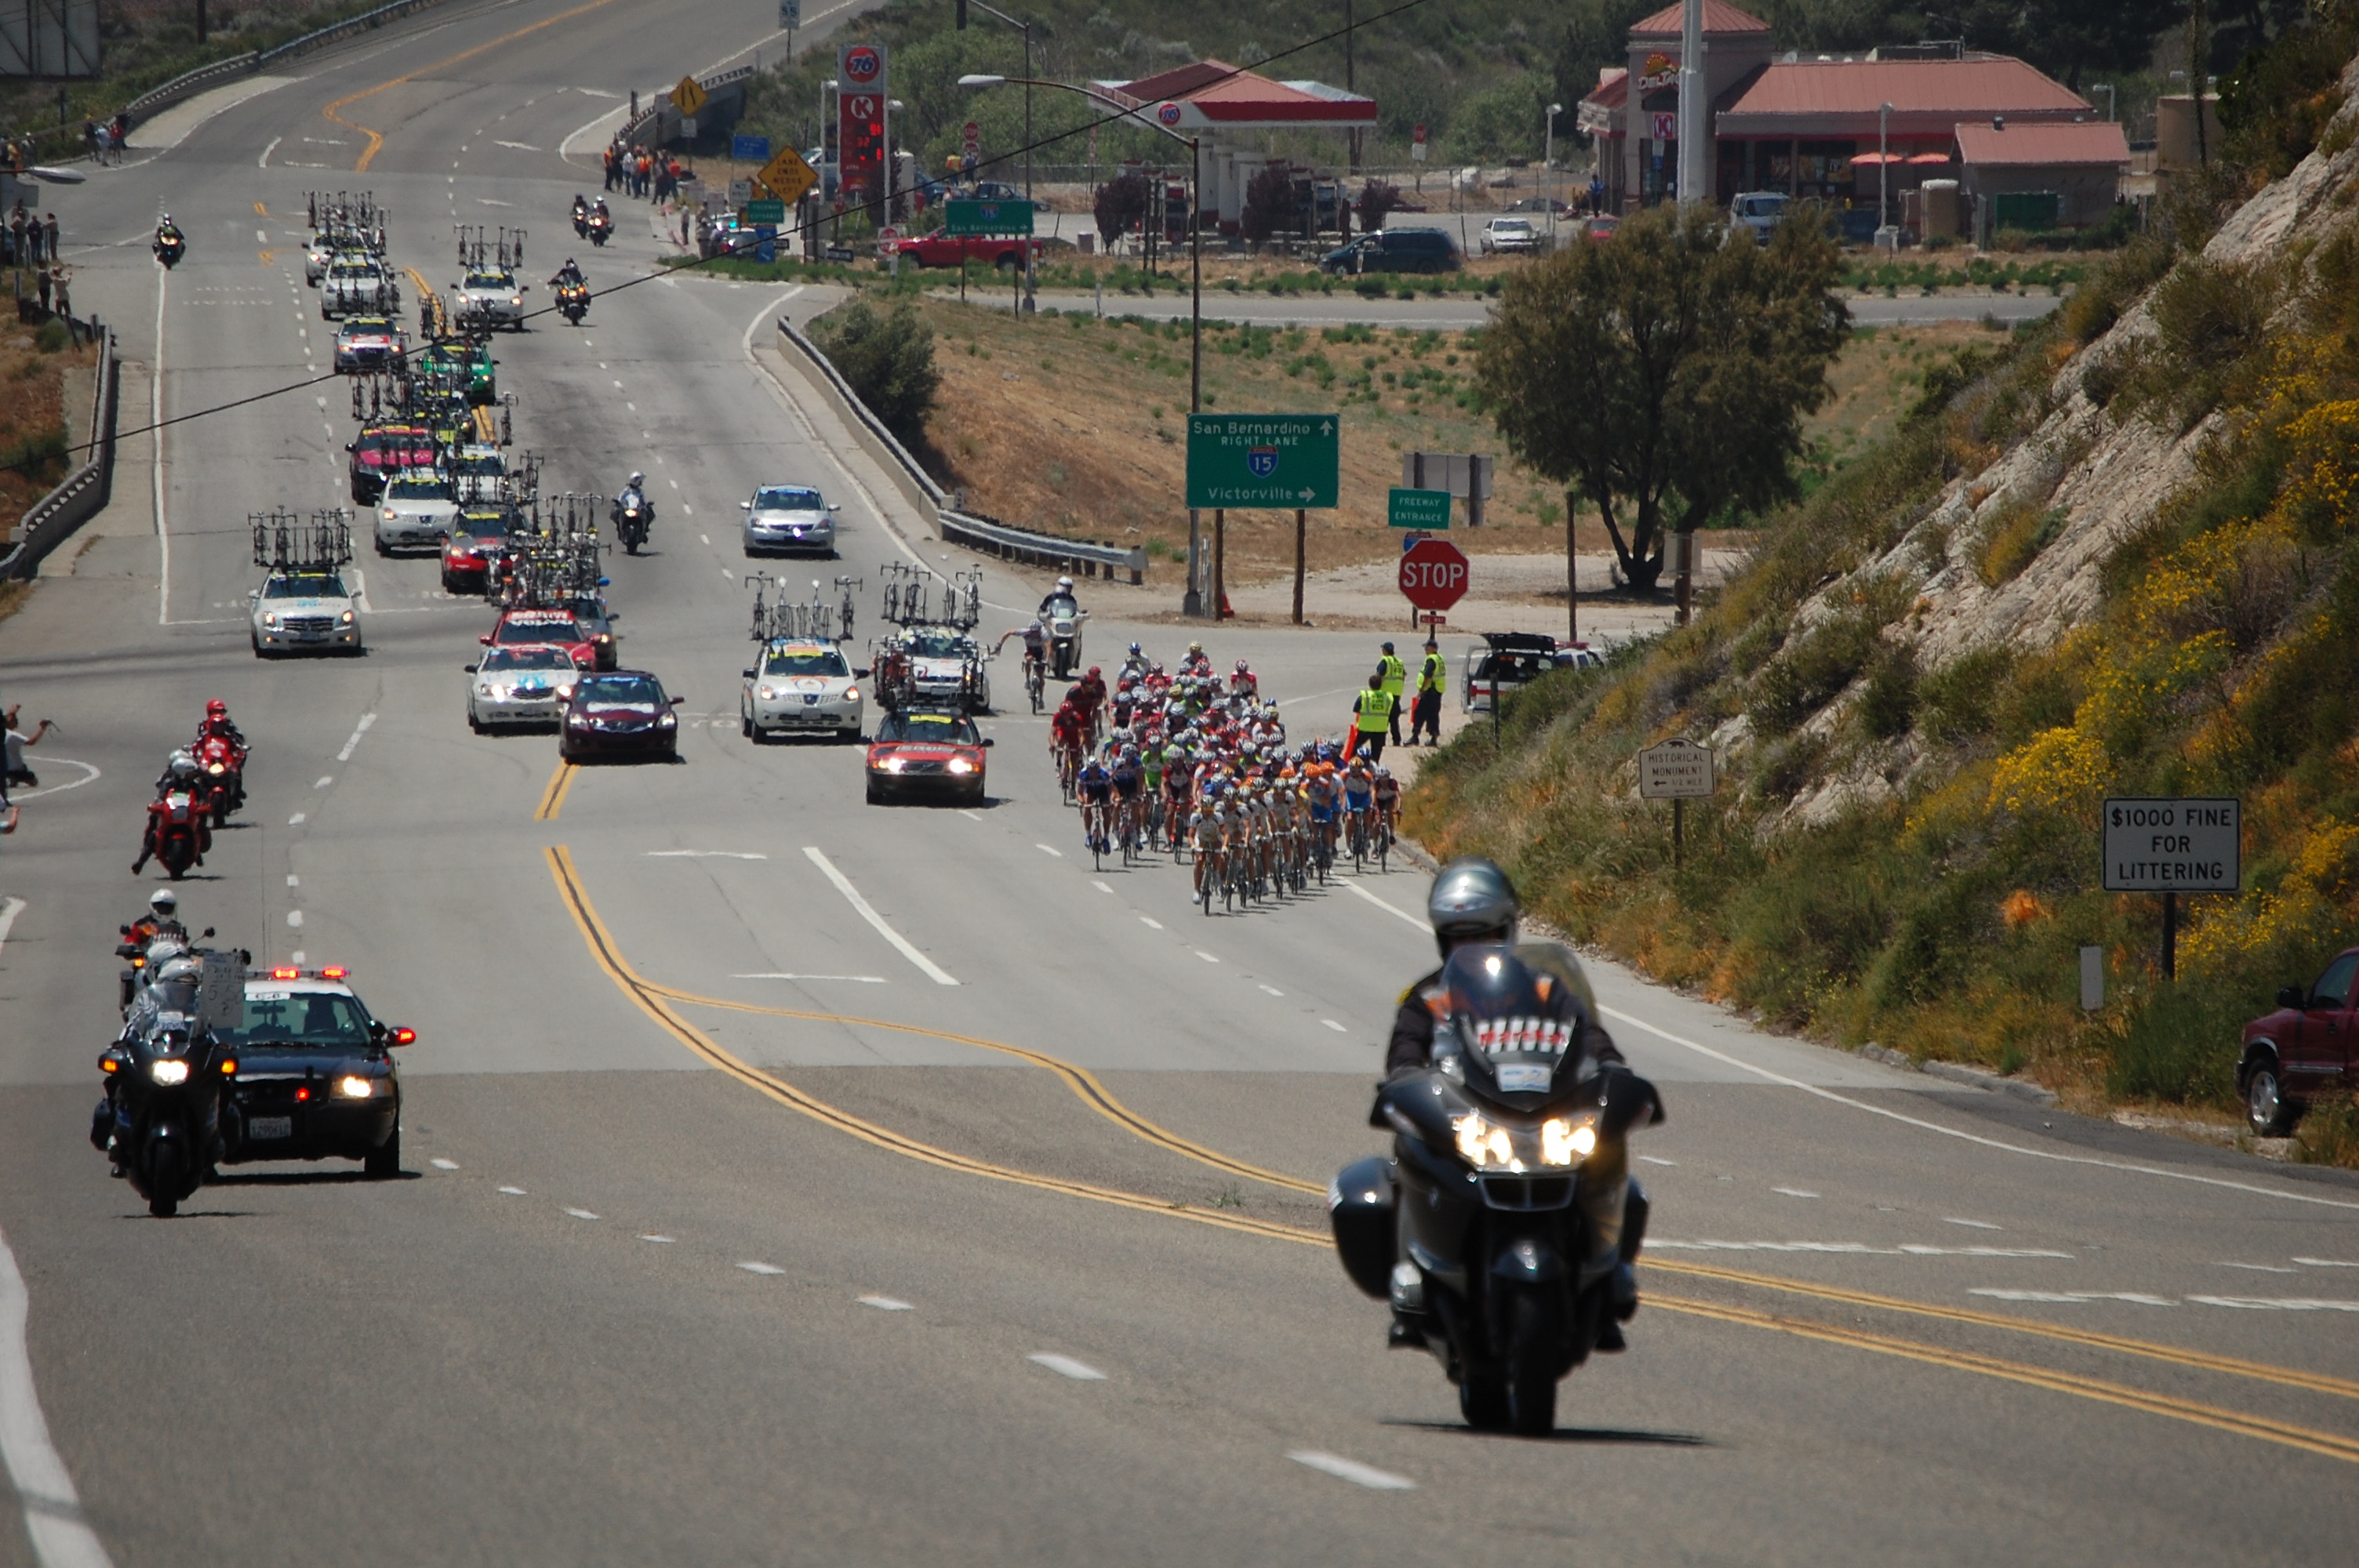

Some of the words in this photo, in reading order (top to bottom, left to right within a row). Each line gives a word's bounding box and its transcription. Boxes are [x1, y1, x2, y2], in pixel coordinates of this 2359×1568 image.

[850, 56, 874, 74] 76
[1161, 106, 1180, 121] 76
[1194, 421, 1221, 434] San
[1228, 422, 1310, 435] Bernardino
[1221, 436, 1259, 446] RIGHT
[1266, 437, 1299, 446] LANE
[1255, 456, 1272, 471] 15
[1209, 487, 1292, 500] Victorville
[1399, 497, 1441, 506] FREEWAY
[1394, 512, 1442, 522] ENTRANCE
[1403, 561, 1464, 588] STOP
[1648, 753, 1704, 763] HISTORICAL
[1652, 766, 1703, 777] MONUMENT
[2110, 807, 2173, 829] $1000
[2186, 807, 2232, 827] FINE
[2151, 834, 2190, 854] FOR
[2118, 862, 2223, 881] LITTERING
